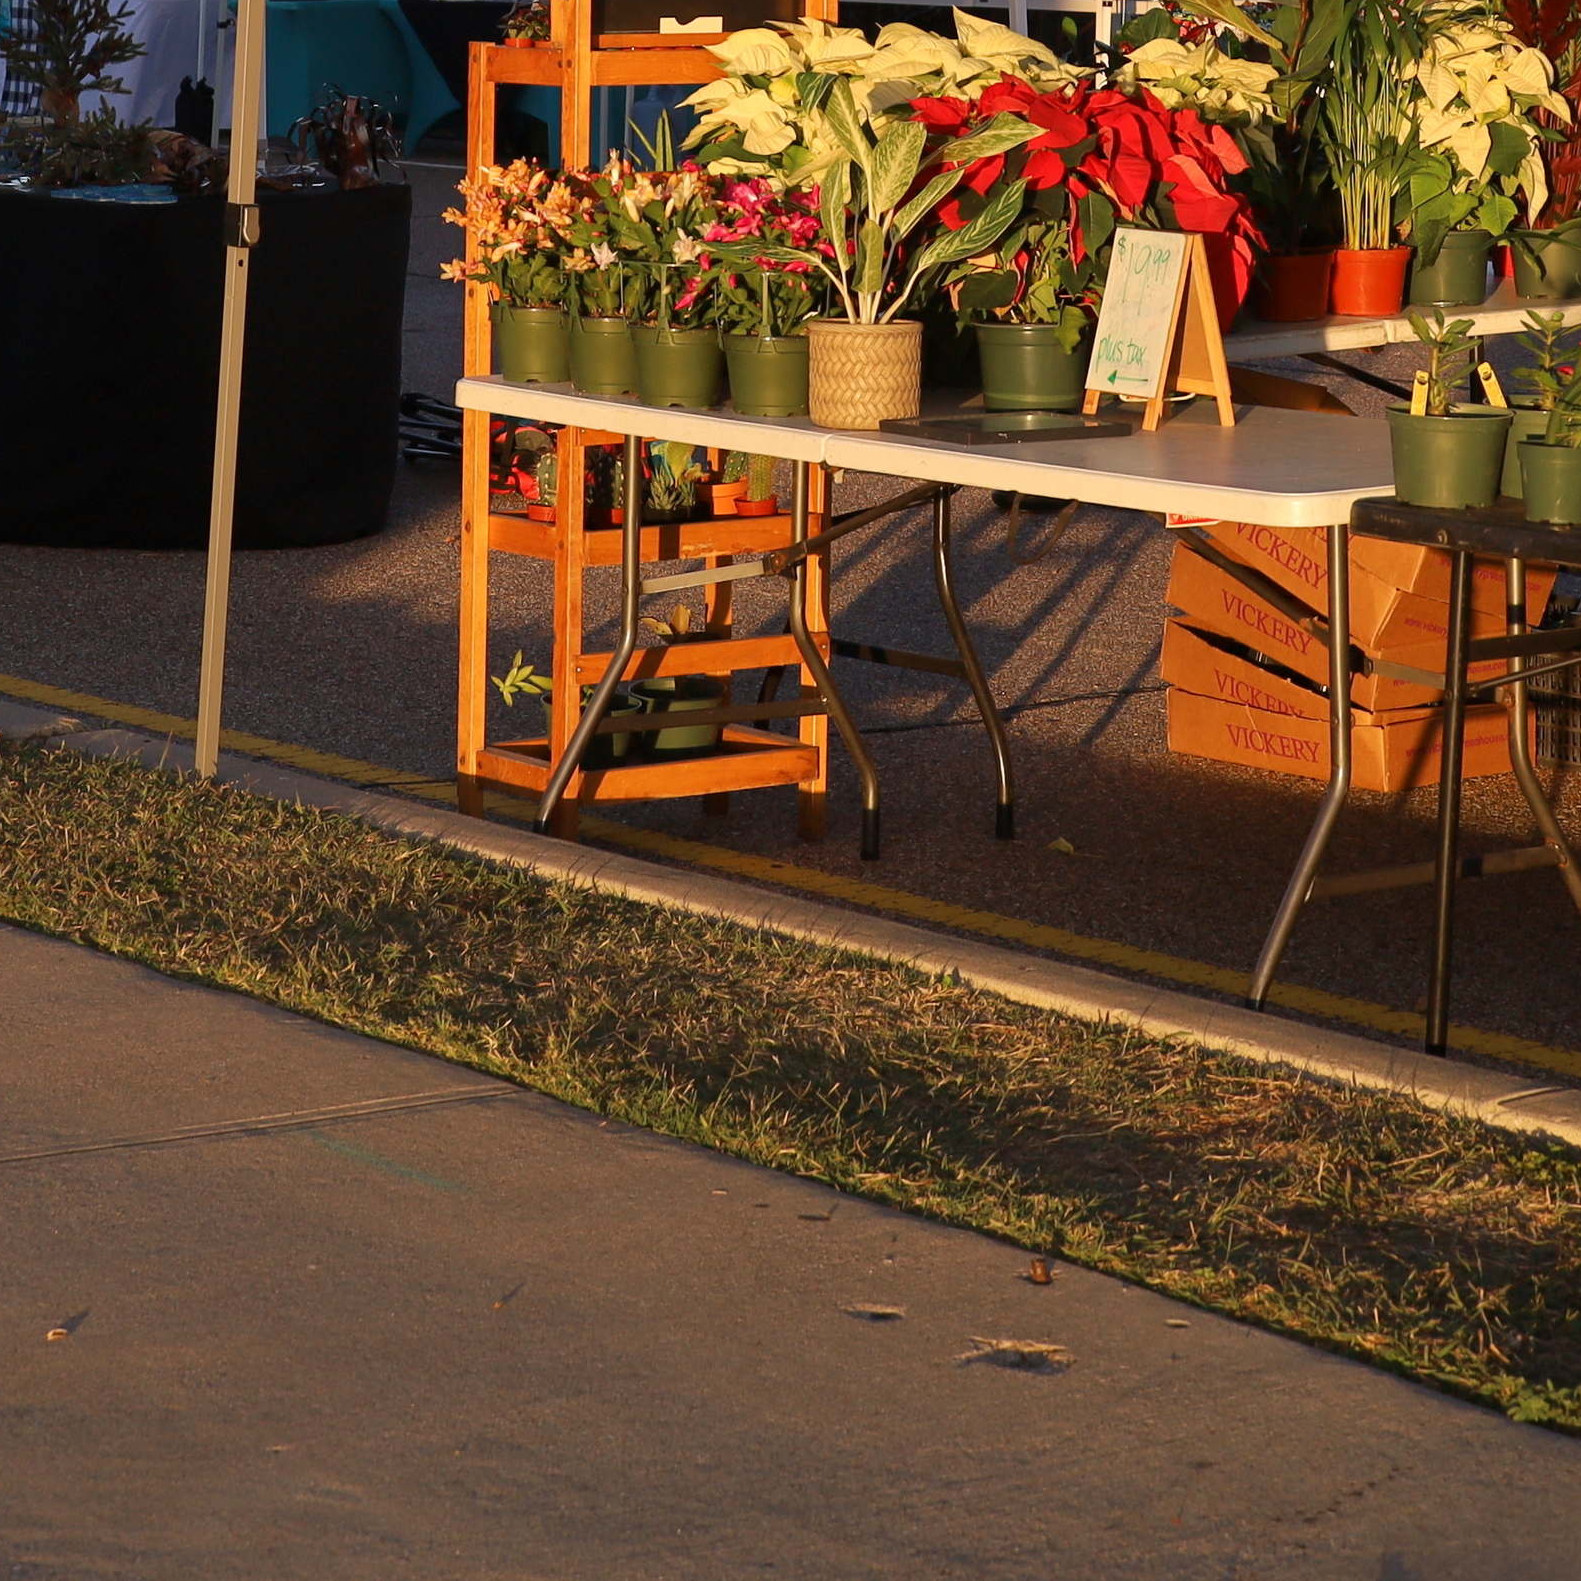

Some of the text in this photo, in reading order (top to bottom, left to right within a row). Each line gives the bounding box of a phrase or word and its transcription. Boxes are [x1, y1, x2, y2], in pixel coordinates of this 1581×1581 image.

[1095, 333, 1148, 373] plus tax
[1236, 522, 1328, 590] VICKERY
[1221, 588, 1315, 656] VICKERY
[1225, 723, 1321, 764] VICKERY
